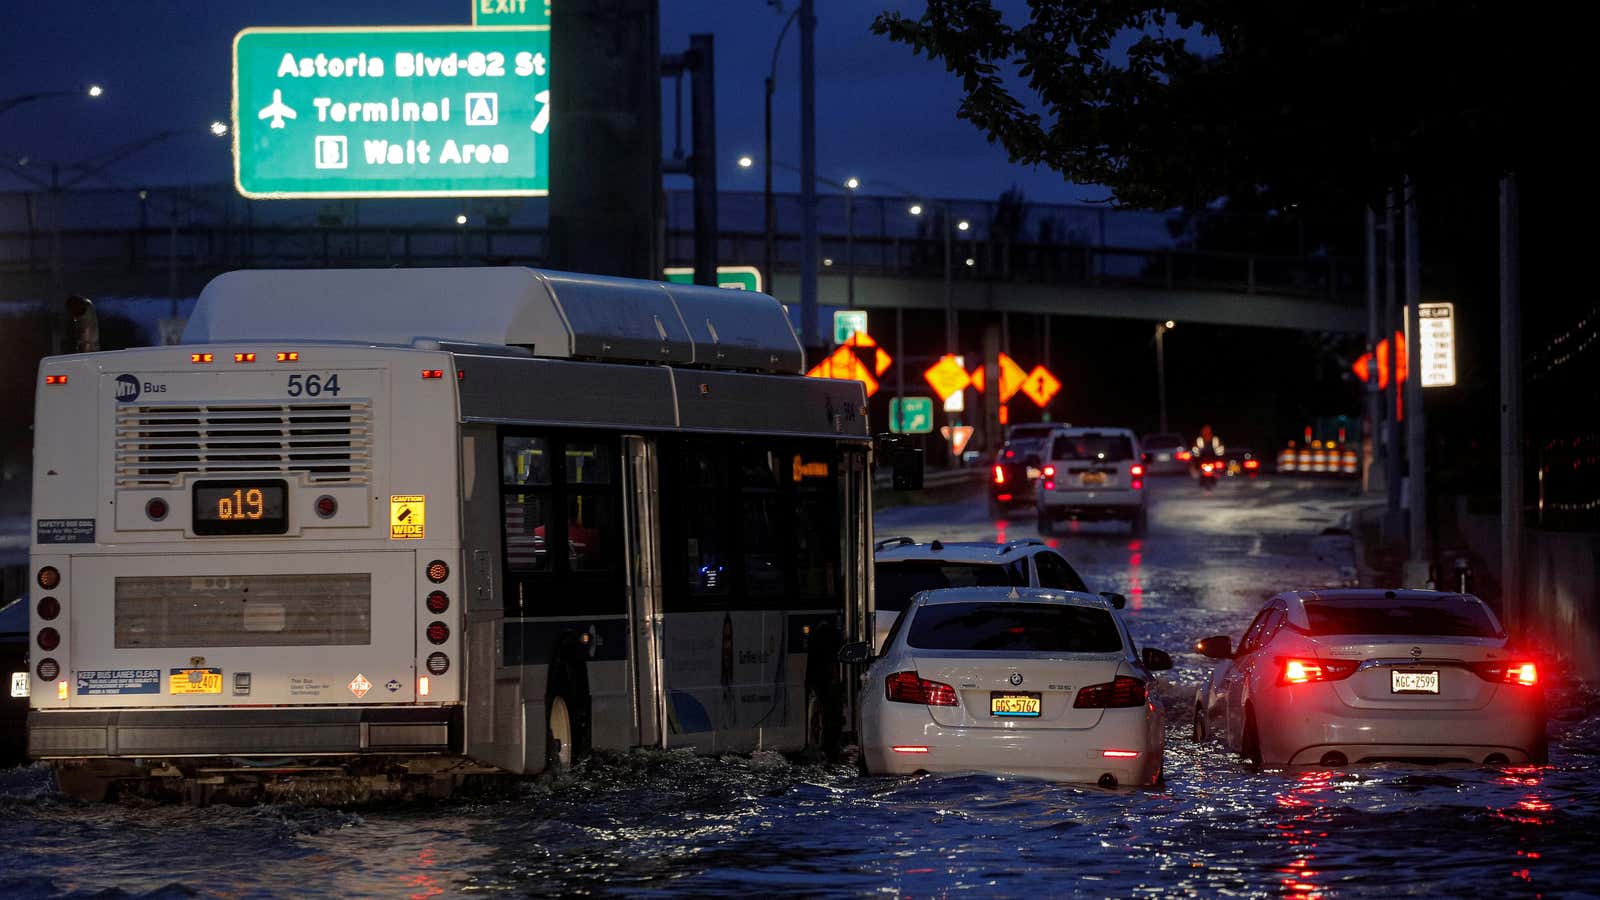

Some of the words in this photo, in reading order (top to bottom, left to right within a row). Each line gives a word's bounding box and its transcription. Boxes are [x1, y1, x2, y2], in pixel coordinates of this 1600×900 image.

[480, 0, 526, 14] EXIT
[277, 52, 384, 78] Astoria
[515, 51, 546, 77] St
[313, 97, 450, 122] Terminal
[470, 96, 494, 122] A
[364, 139, 430, 165] Wait
[439, 139, 510, 164] Area
[144, 382, 167, 393] Bus
[287, 373, 340, 397] 564
[393, 526, 423, 534] WIDE
[78, 671, 97, 679] KEEP
[97, 671, 111, 679] BUS
[112, 671, 135, 679] LANES
[135, 670, 159, 678] CLEAR
